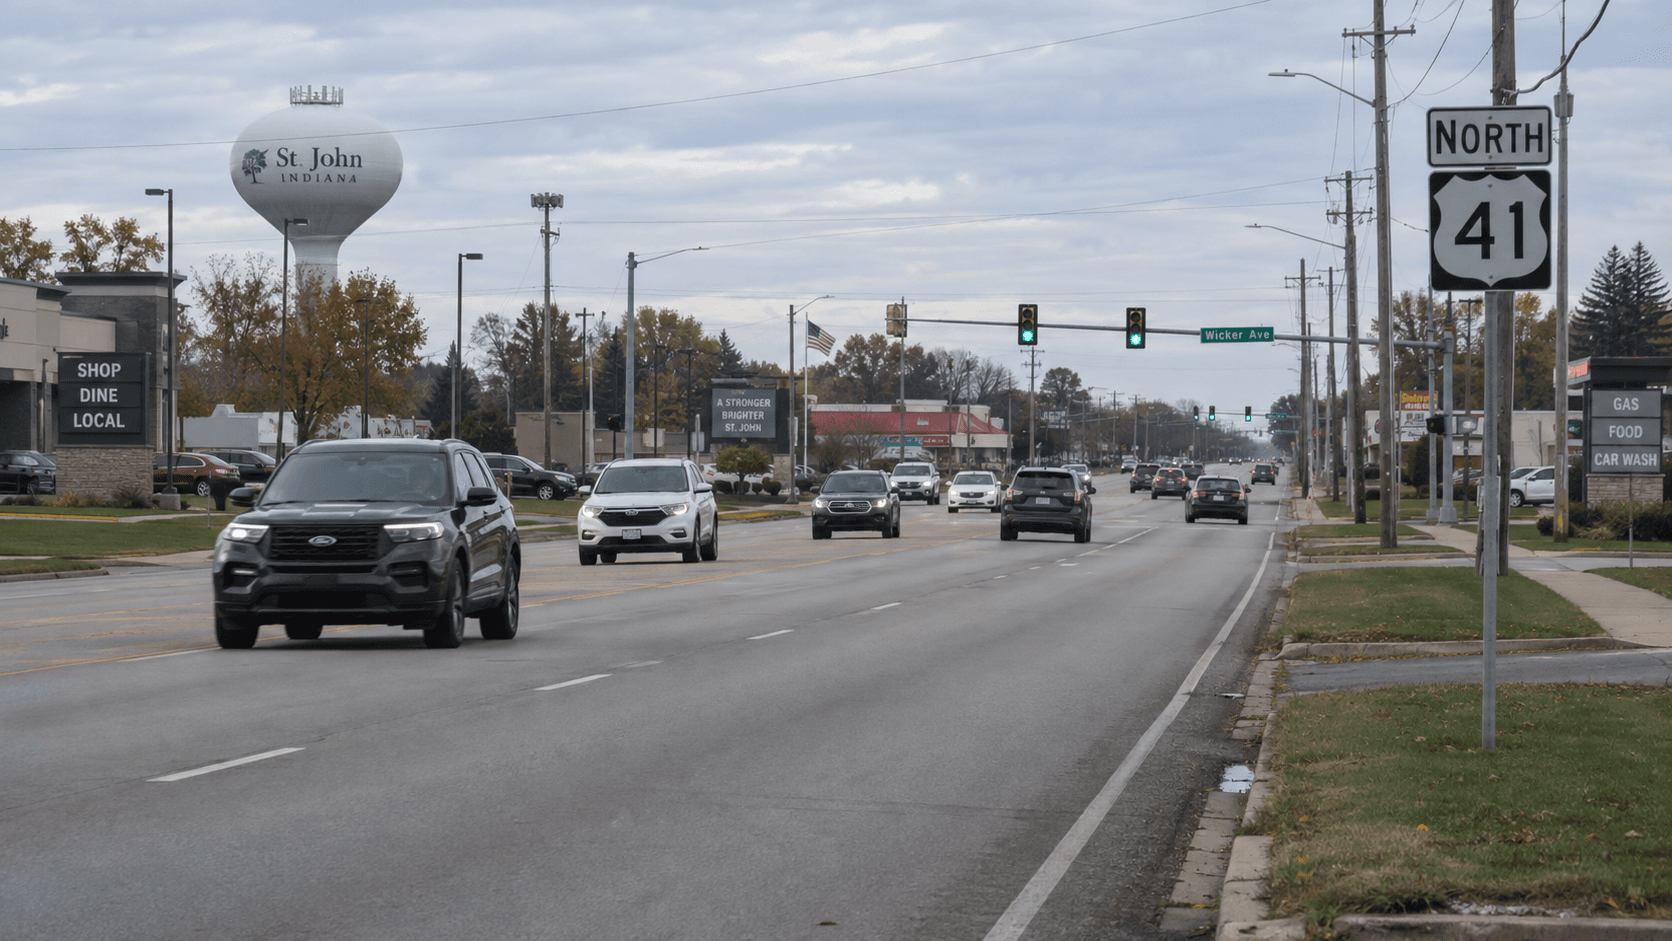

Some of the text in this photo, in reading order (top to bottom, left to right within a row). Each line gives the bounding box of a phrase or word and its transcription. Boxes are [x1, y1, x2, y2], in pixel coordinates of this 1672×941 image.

[1436, 119, 1543, 154] NORTH
[276, 146, 363, 172] St. John
[281, 173, 357, 184] INDIANA
[1454, 201, 1524, 260] 41
[1205, 330, 1270, 340] Wicker Ave
[77, 362, 122, 378] SHOP
[80, 388, 118, 402] DINE
[717, 398, 771, 407] A STRONGER
[1613, 397, 1639, 411] GAS
[73, 412, 125, 428] LOCAL
[721, 411, 765, 420] BRIGHTER
[725, 423, 761, 432] ST. JOHN
[1609, 425, 1643, 439] FOOD
[1594, 452, 1658, 466] CAR WASH
